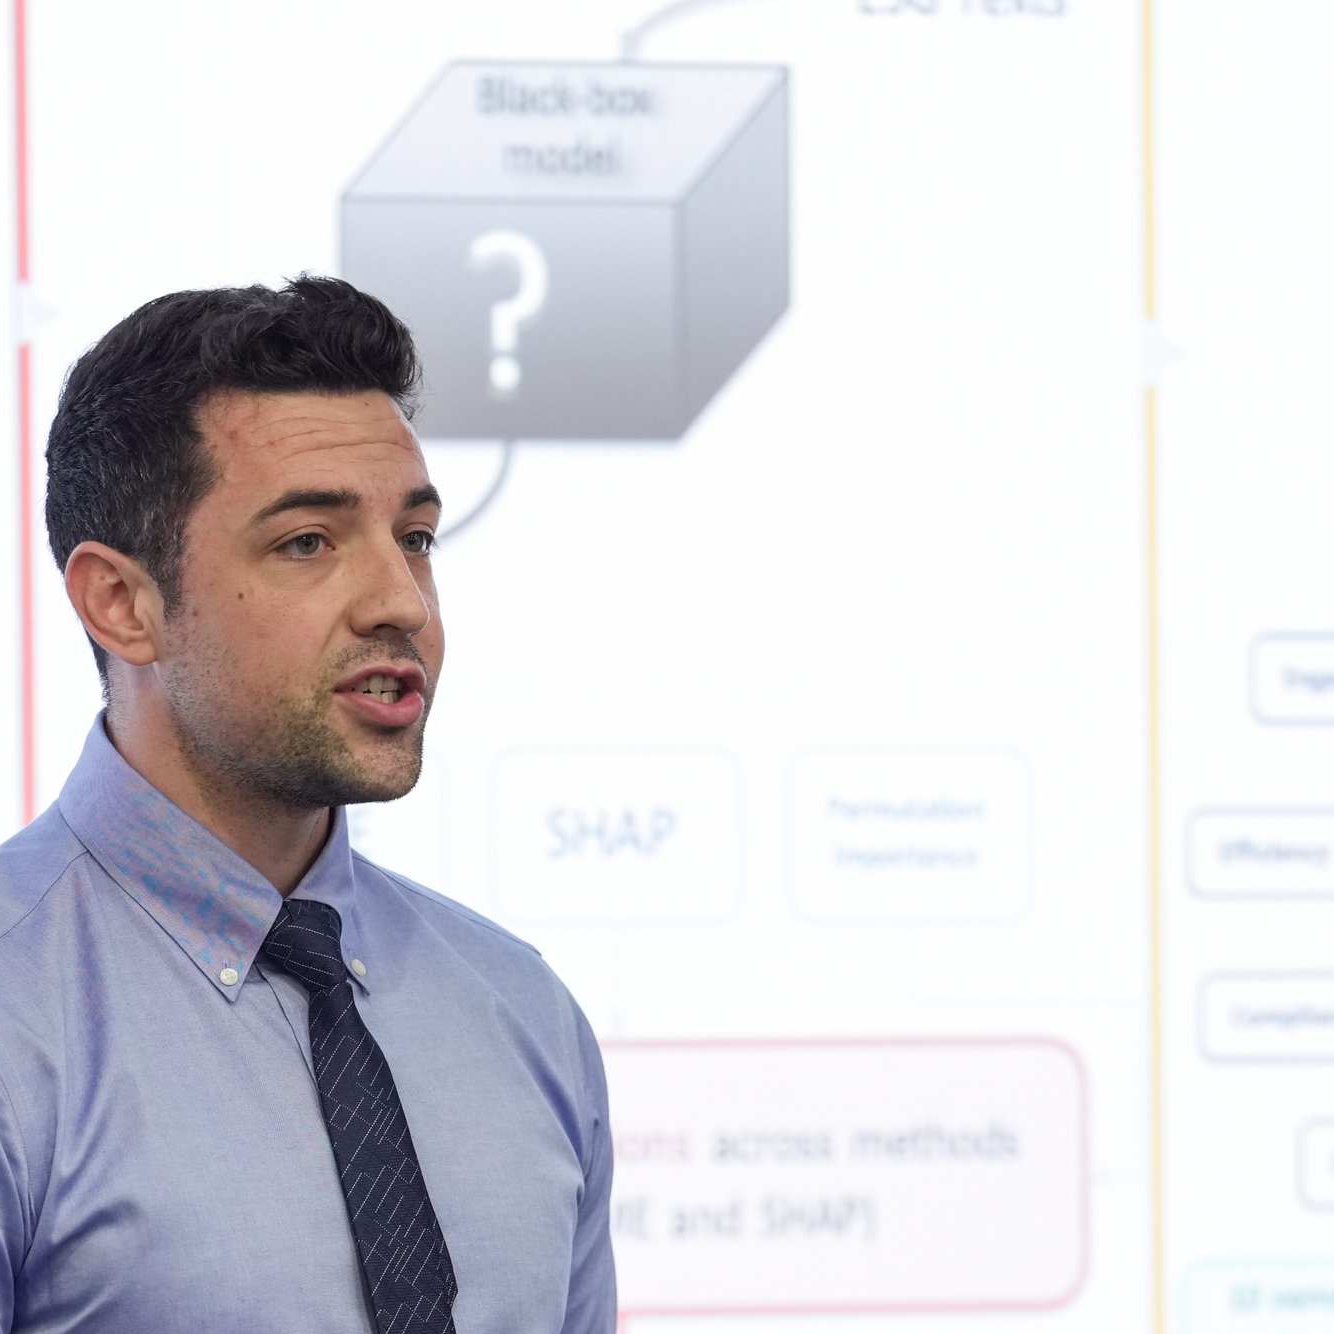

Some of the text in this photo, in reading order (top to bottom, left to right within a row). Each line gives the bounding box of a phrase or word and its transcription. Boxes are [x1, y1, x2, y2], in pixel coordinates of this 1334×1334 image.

[475, 76, 657, 116] Black-box
[501, 135, 624, 176] model
[467, 228, 549, 391] ?
[544, 802, 679, 862] SHAP
[713, 1130, 835, 1162] across
[850, 1119, 1021, 1162] methods
[670, 1198, 745, 1240] and
[759, 1196, 879, 1246] SHAP)
